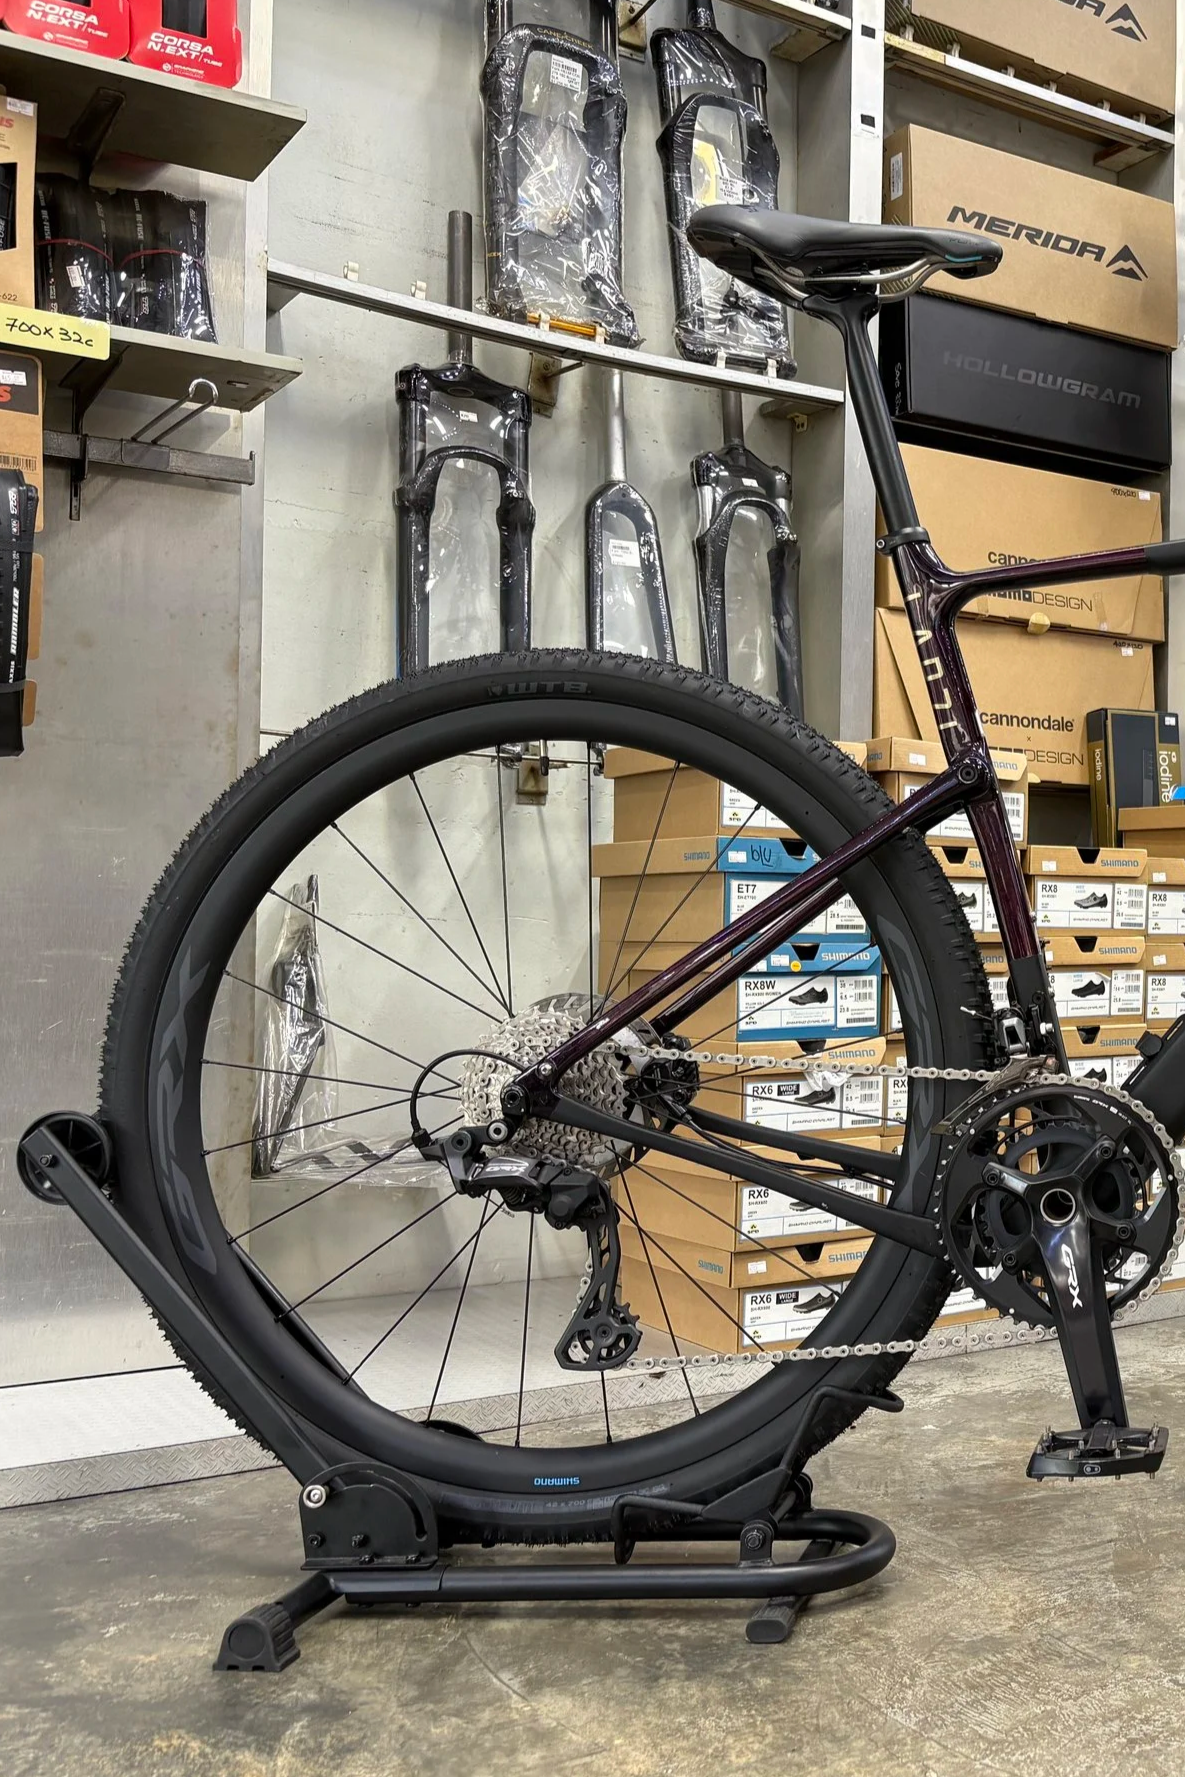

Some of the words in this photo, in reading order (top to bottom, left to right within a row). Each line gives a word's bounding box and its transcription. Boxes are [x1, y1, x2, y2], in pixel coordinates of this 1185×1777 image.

[30, 1, 98, 25] CORSA
[87, 27, 108, 38] TUBE
[150, 32, 213, 55] CORSA
[203, 58, 222, 67] TUBE
[947, 205, 1107, 263] MERIDA
[943, 350, 1141, 409] HOLLOWGRAM
[980, 711, 1075, 732] cannondale
[993, 760, 1018, 771] MANO
[1094, 748, 1104, 782] iodine
[1159, 750, 1177, 804] iodine
[684, 852, 710, 861] SHIMANO
[1101, 859, 1139, 868] SHIMANO
[737, 884, 757, 894] ET7
[1041, 884, 1058, 893] RX8
[1152, 894, 1167, 902] RX8
[1099, 946, 1137, 955] SHIMANO
[821, 952, 871, 962] SHIMANO
[744, 980, 776, 991] RX8W
[1151, 978, 1167, 986] RX8
[1100, 1037, 1138, 1047] SHIMANO
[828, 1049, 875, 1059] SHIMANO
[752, 1085, 773, 1096] RX6
[485, 1165, 527, 1173] GRX
[748, 1188, 770, 1199] RX6
[698, 1259, 723, 1275] SHIMANO
[1061, 1243, 1083, 1309] GRX
[750, 1294, 772, 1305] RX6
[534, 1477, 580, 1486] SHIMANO
